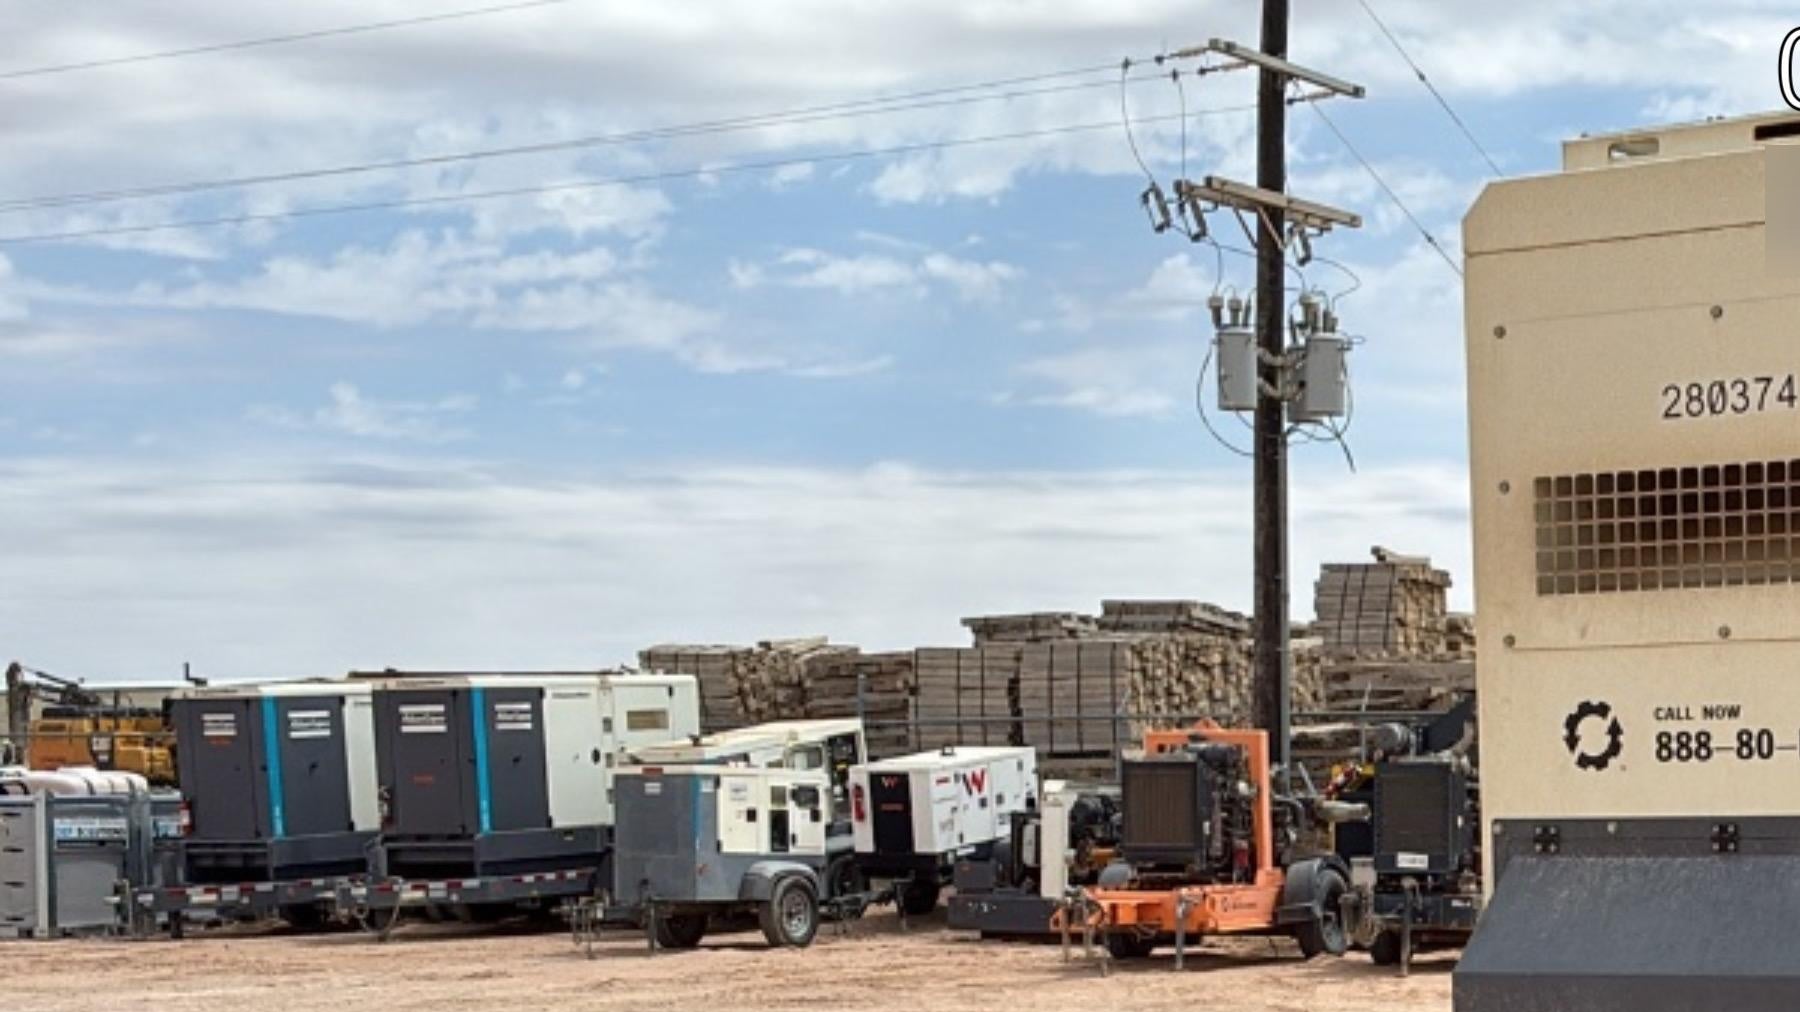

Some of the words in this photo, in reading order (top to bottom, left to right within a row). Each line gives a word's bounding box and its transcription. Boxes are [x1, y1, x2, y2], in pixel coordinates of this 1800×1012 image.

[1662, 374, 1798, 419] 280374
[1654, 706, 1694, 721] CALL
[1703, 704, 1741, 720] NOW
